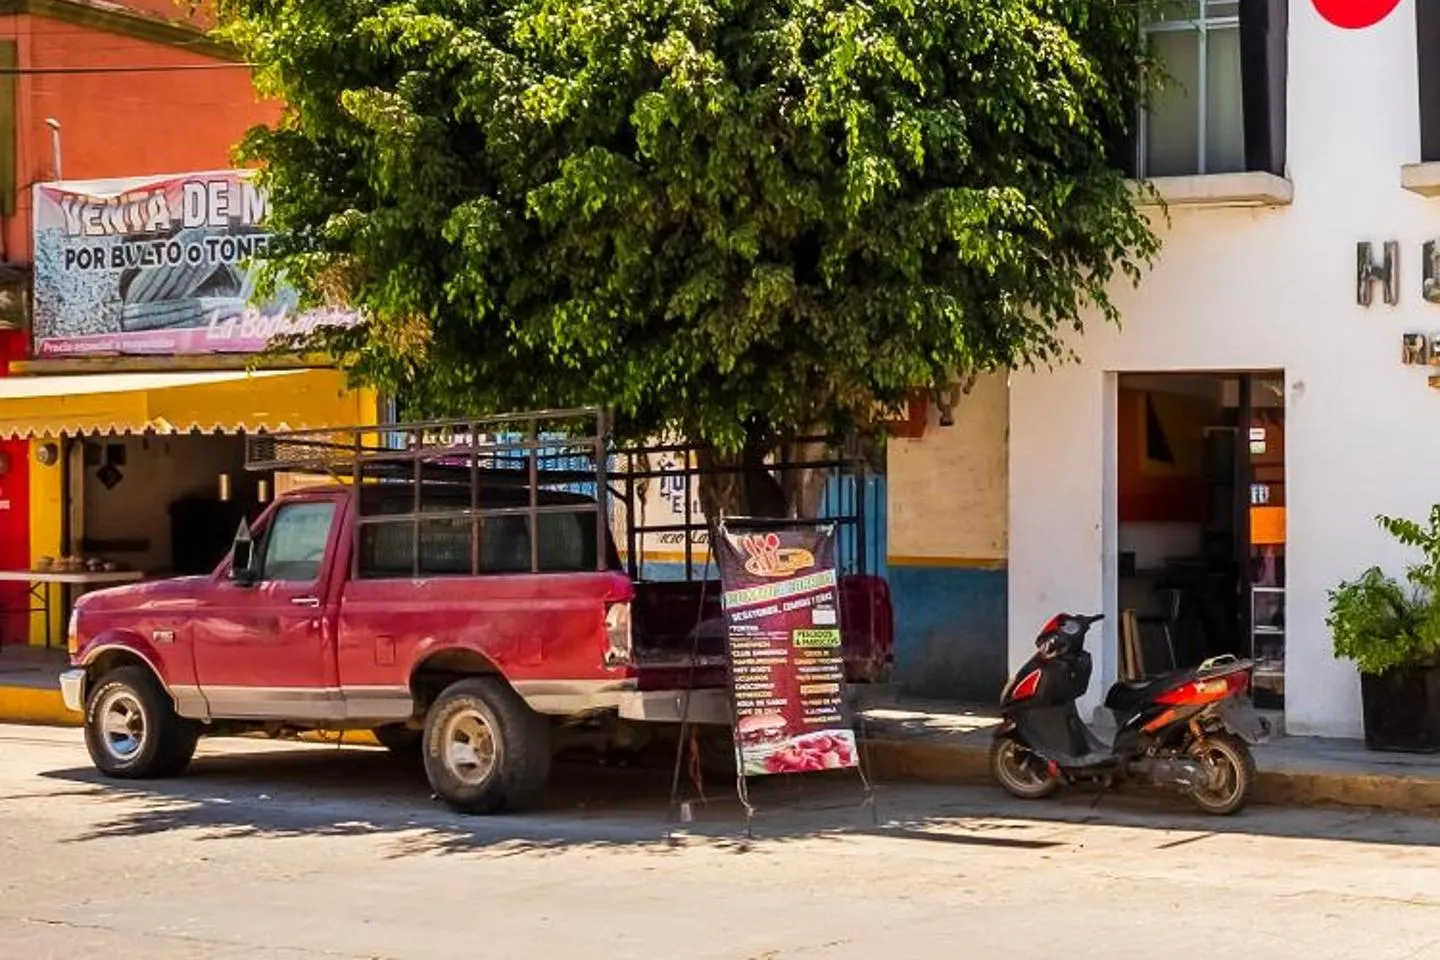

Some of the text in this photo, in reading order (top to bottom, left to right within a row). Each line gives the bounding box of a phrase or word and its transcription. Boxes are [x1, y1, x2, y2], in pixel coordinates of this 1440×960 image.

[60, 189, 173, 237] VENTA
[182, 180, 229, 229] DE
[65, 247, 105, 271] POR
[111, 241, 182, 268] BULTO
